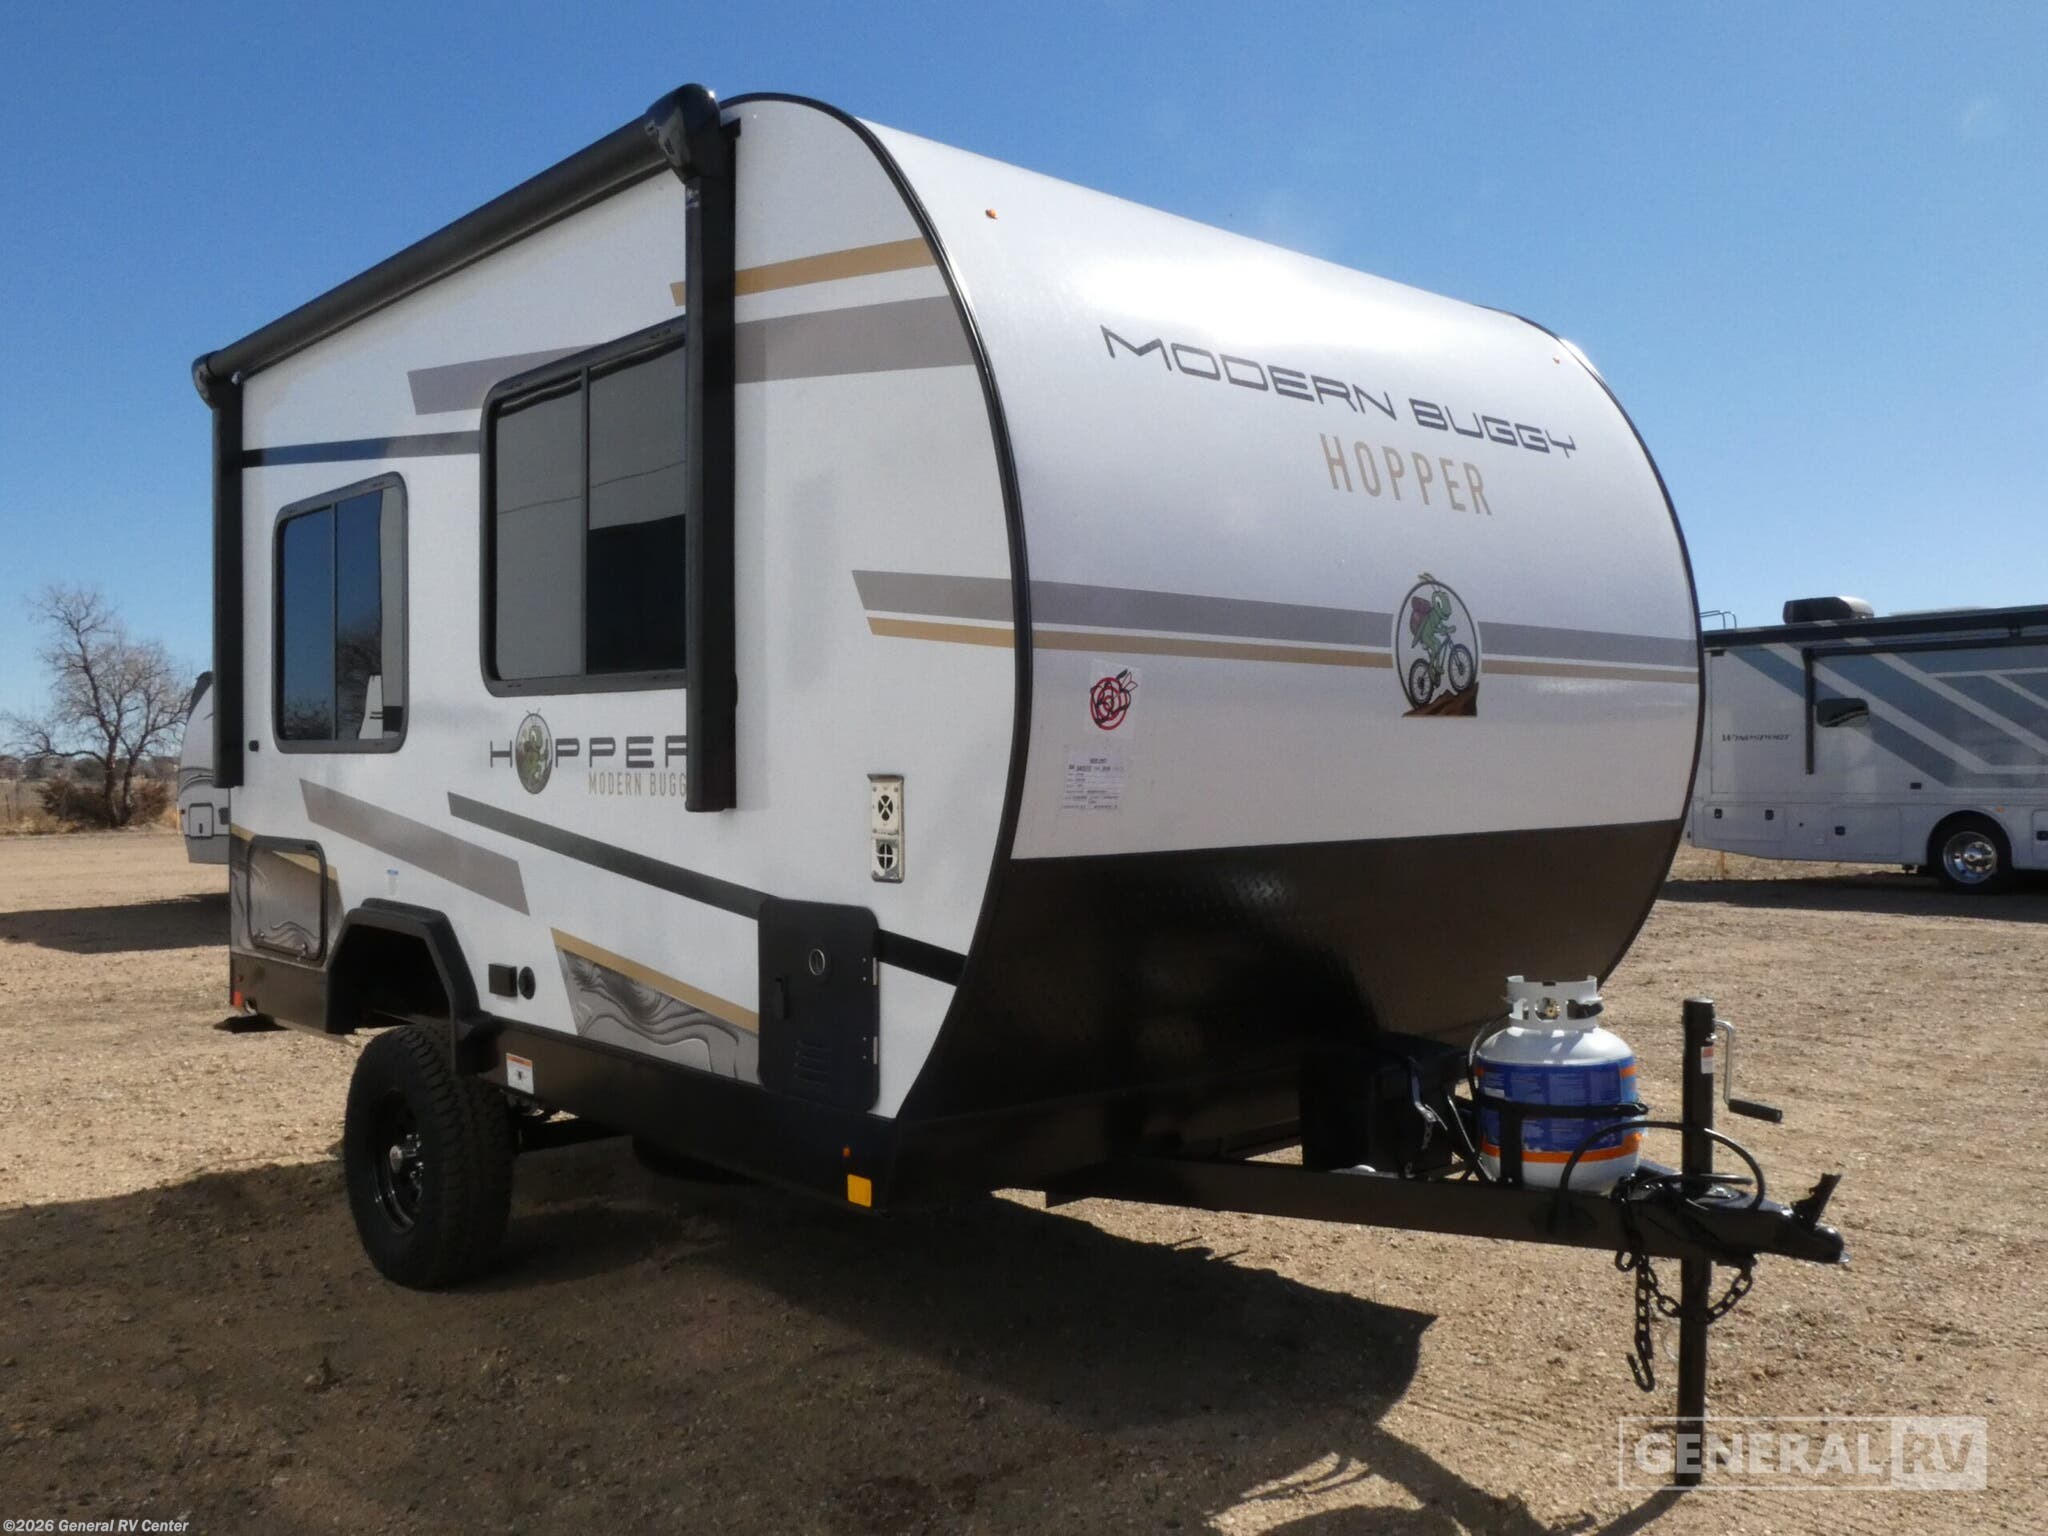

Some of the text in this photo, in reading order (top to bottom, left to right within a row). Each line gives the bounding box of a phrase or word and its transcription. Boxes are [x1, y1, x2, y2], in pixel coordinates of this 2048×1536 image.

[1100, 325, 1577, 458] MODERN BUGGY
[1319, 433, 1493, 516] HOPPER
[588, 772, 687, 796] MODERN BUGG
